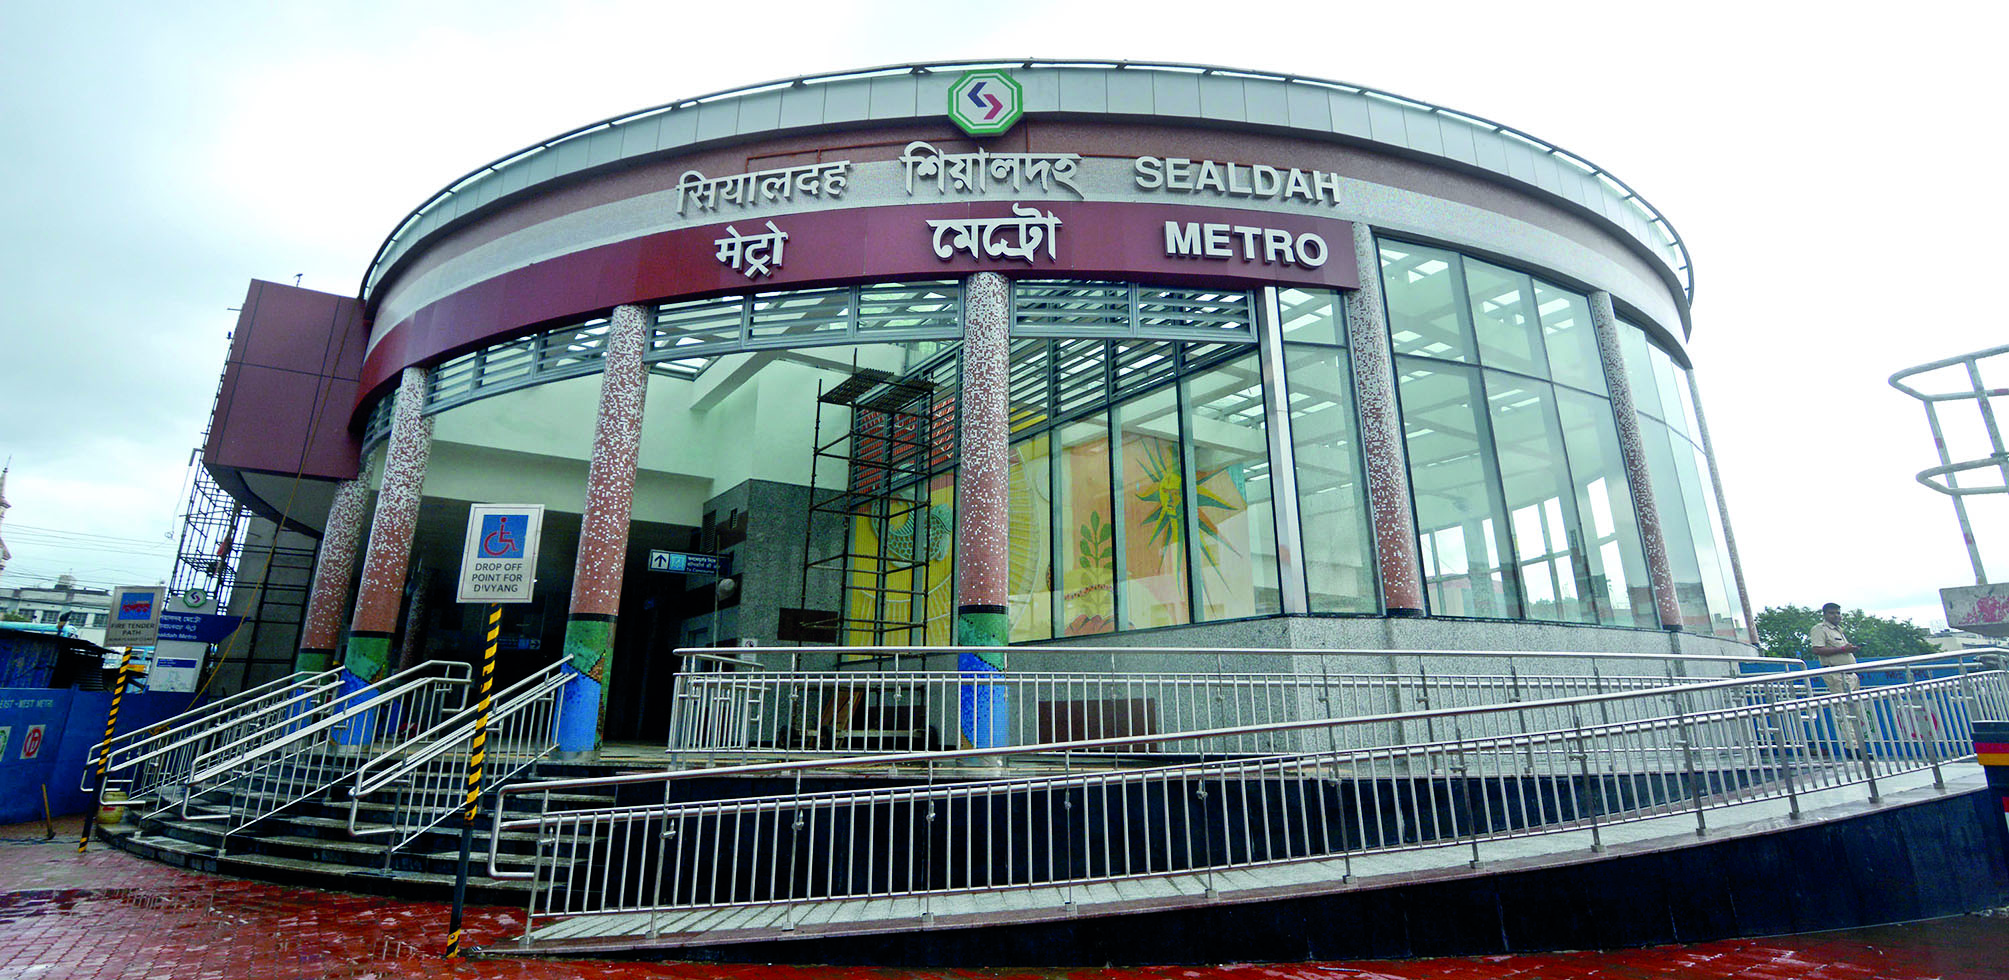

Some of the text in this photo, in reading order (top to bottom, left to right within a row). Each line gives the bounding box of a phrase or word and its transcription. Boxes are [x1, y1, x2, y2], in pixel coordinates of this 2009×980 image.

[675, 160, 850, 215] सियालदह
[899, 141, 1085, 199] শিয়ালদহ
[1135, 156, 1340, 204] SEALDAH
[714, 220, 788, 279] मेट्रो
[925, 202, 1063, 265] মেট্রো
[1164, 221, 1328, 269] METRO
[472, 574, 523, 582] POINT FOR
[473, 584, 518, 592] DIVYANG
[475, 563, 523, 571] DROP OFF
